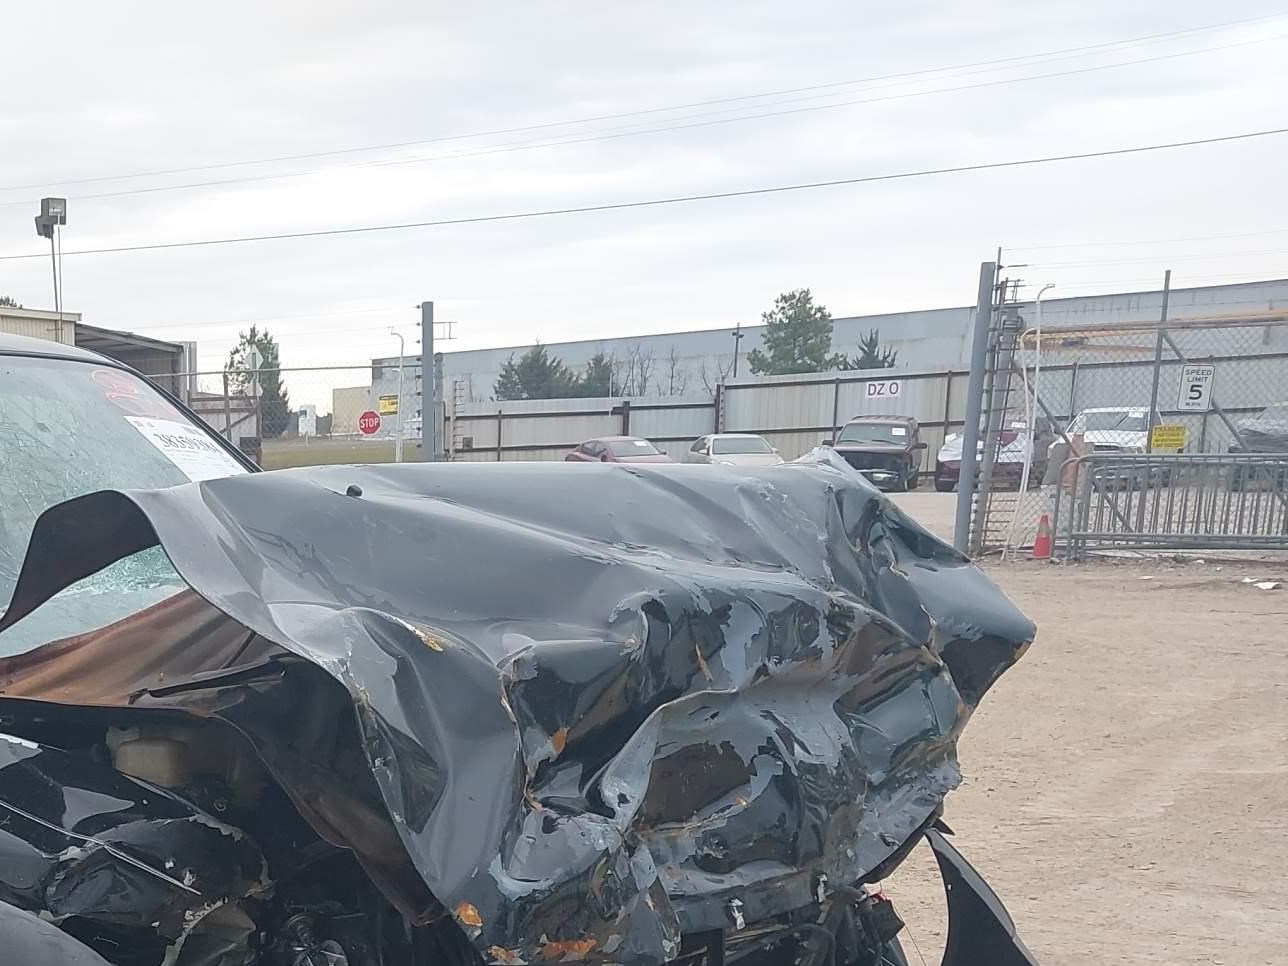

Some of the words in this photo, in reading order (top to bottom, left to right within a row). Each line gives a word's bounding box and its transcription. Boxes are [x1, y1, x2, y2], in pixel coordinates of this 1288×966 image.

[868, 383, 885, 396] DZ
[1188, 384, 1203, 401] 5
[360, 417, 379, 429] STOP
